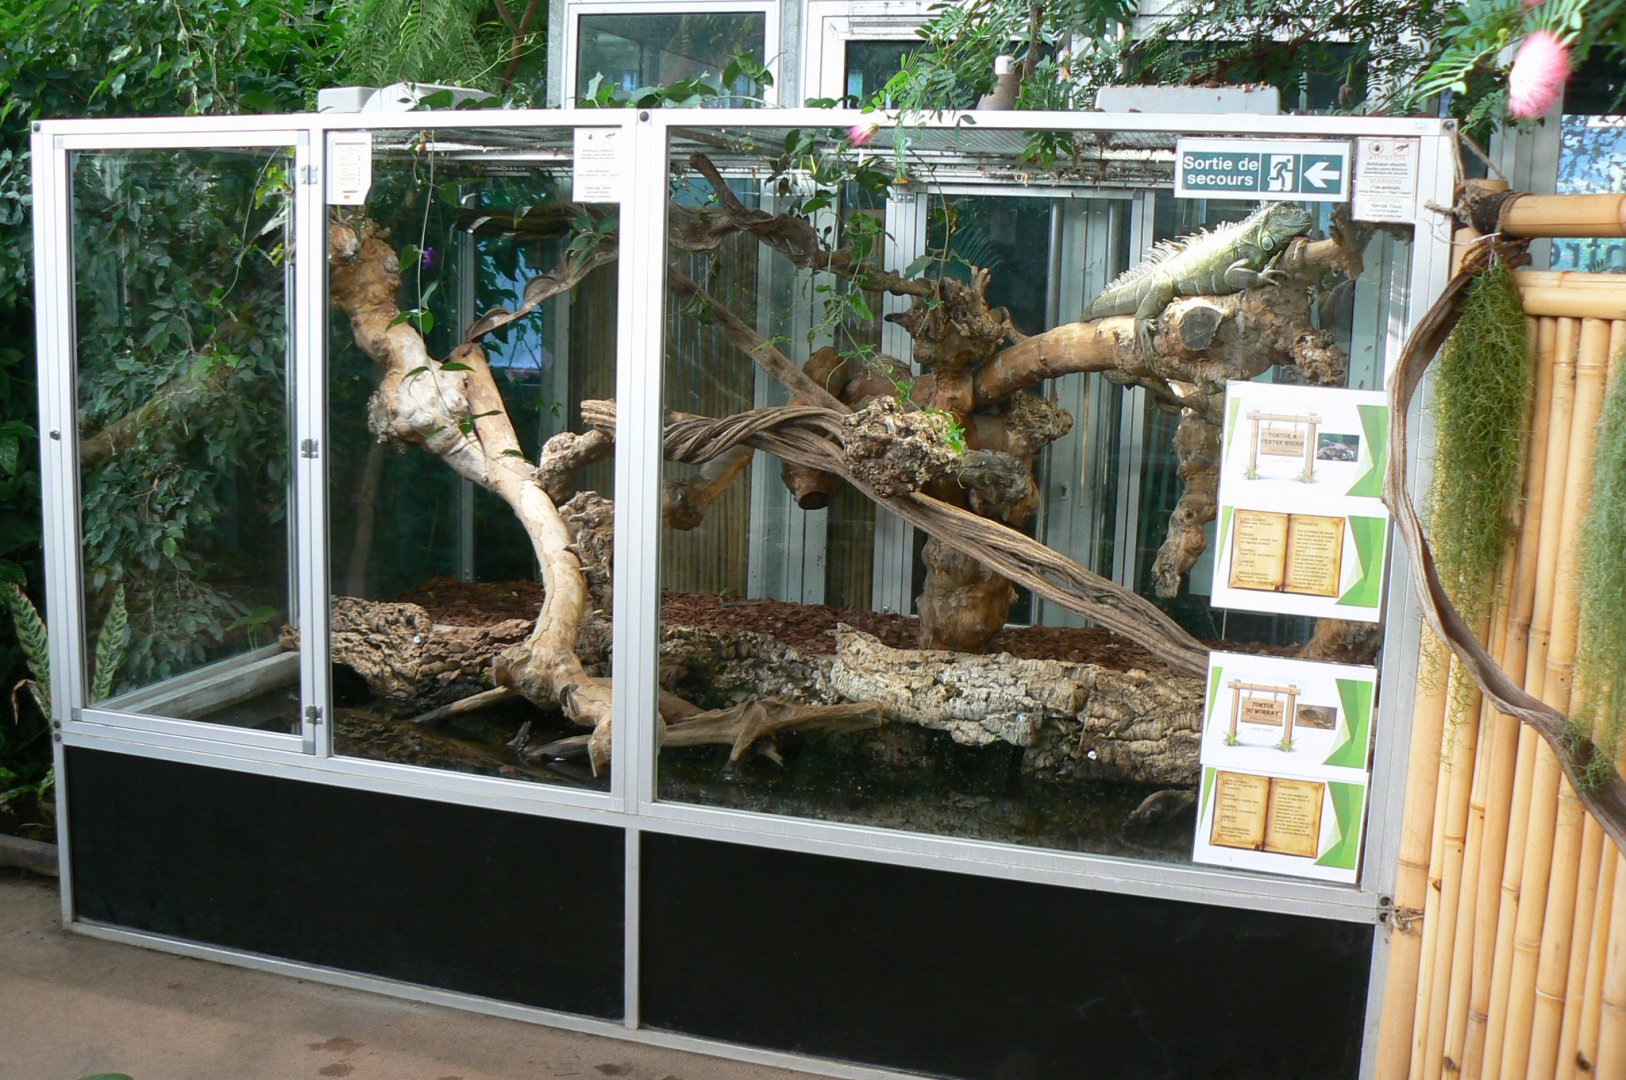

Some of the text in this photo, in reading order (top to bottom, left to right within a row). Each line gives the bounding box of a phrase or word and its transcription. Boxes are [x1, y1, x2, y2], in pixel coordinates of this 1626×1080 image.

[1183, 155, 1259, 171] Sortie de
[1187, 173, 1254, 186] secours
[1252, 701, 1275, 709] TORTUE
